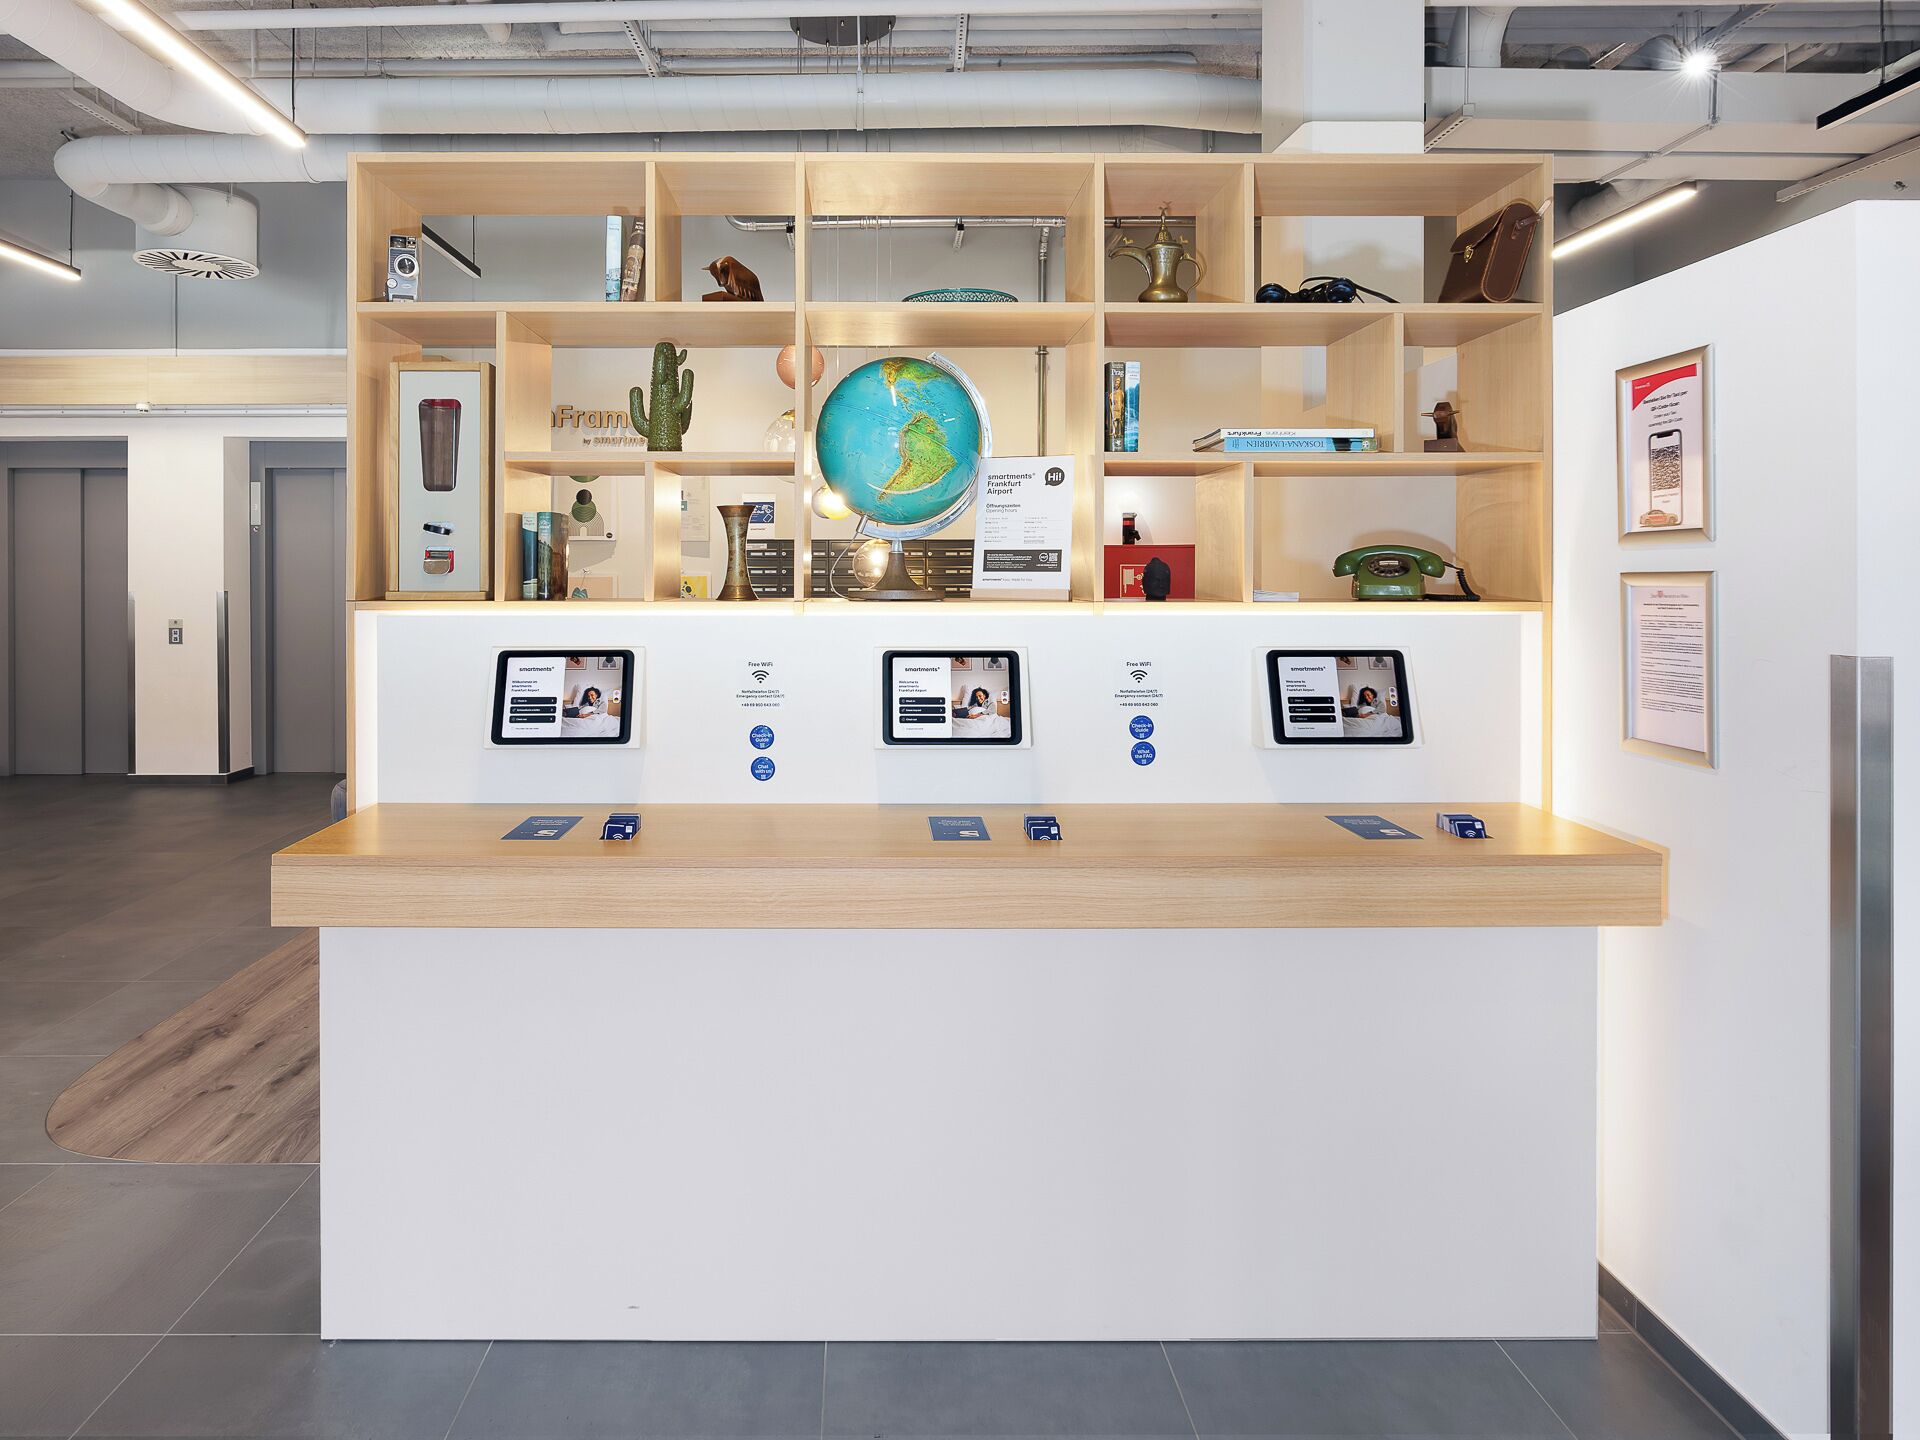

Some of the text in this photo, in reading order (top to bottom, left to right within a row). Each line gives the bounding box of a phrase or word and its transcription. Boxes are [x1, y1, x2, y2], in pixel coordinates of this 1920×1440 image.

[1111, 368, 1124, 377] Prag
[1047, 471, 1062, 482] Hi!
[987, 480, 1022, 488] Frankfurt
[987, 487, 1013, 496] Airport
